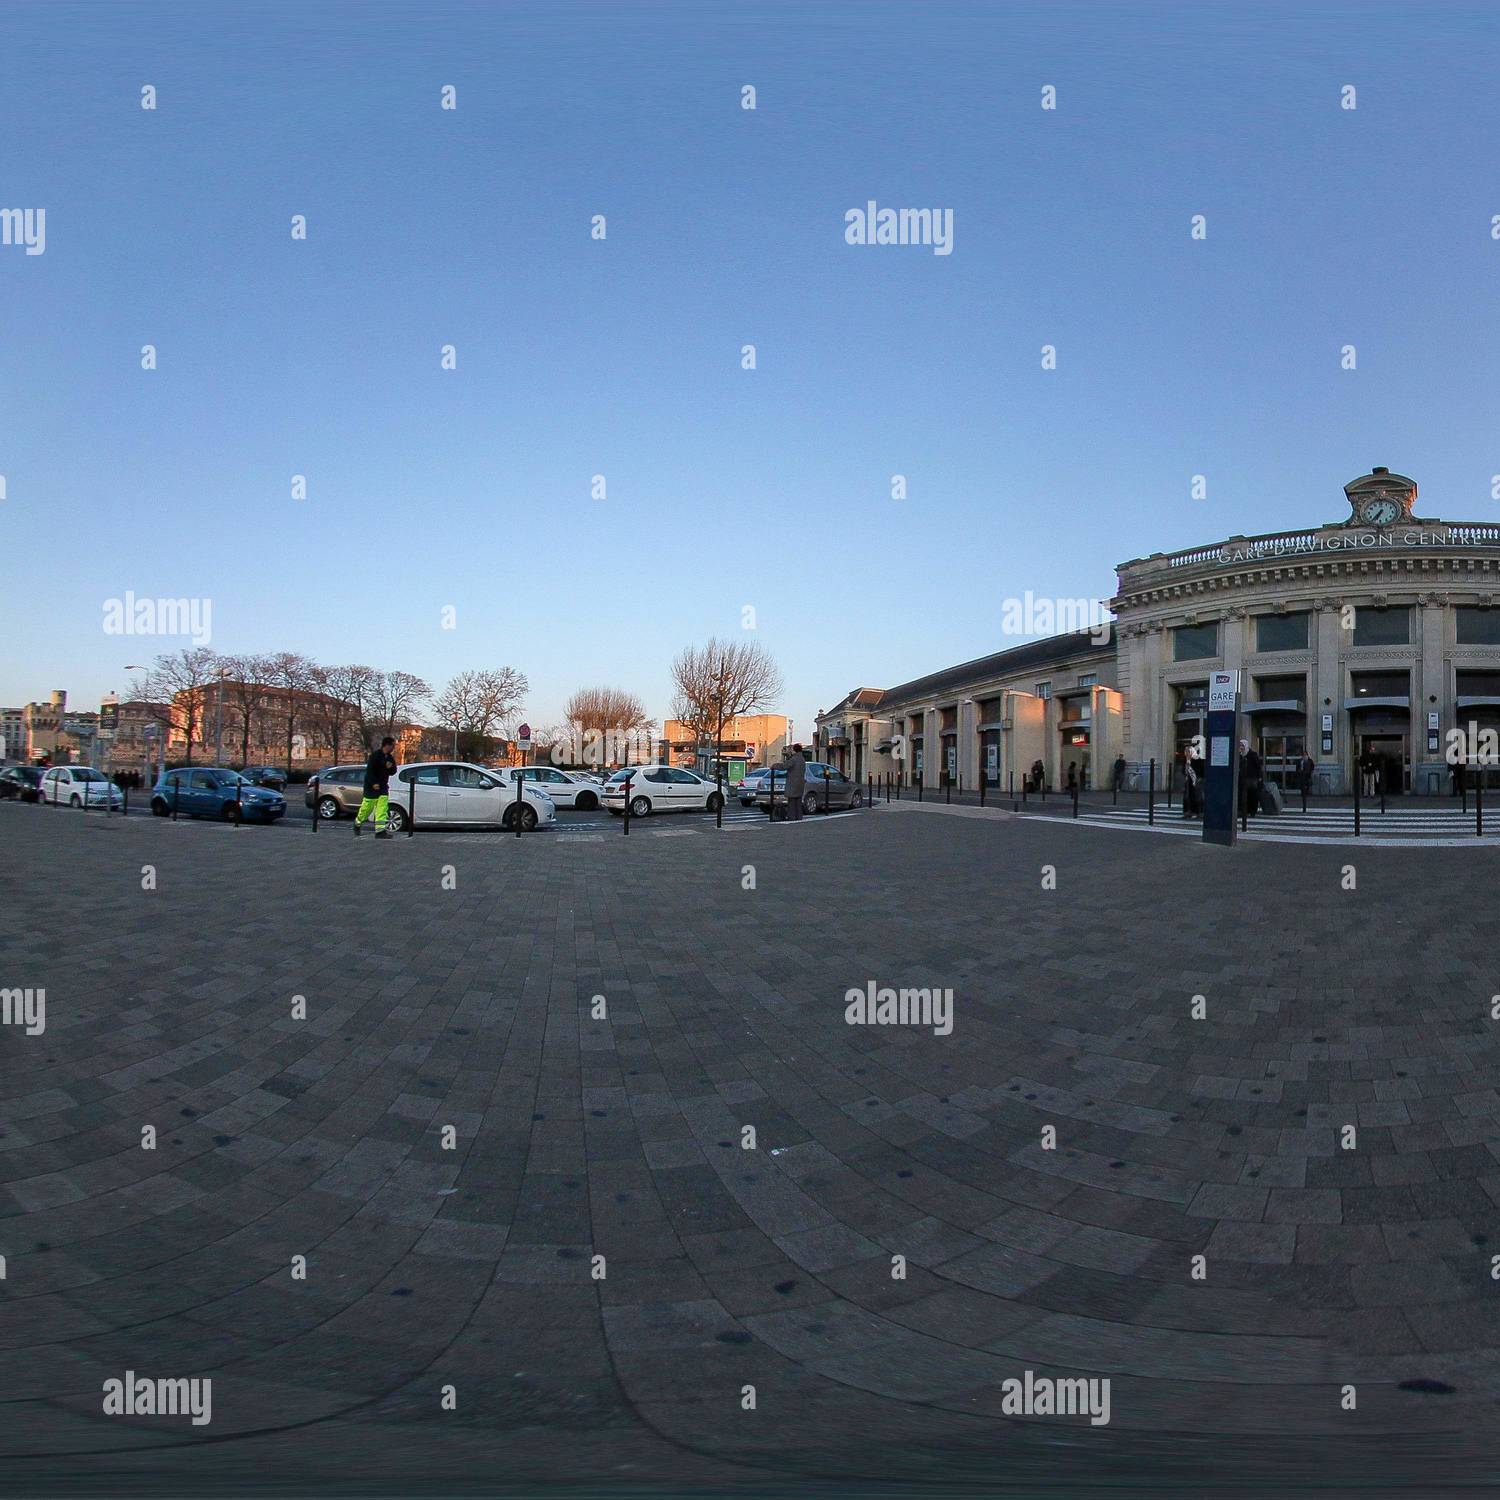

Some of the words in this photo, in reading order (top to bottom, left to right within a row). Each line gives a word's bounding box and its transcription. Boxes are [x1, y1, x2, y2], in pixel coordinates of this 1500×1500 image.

[1218, 547, 1265, 564] GARE
[1274, 533, 1393, 555] D'AVIGNON
[1404, 532, 1482, 545] CENTRE
[1211, 692, 1234, 701] GARE
